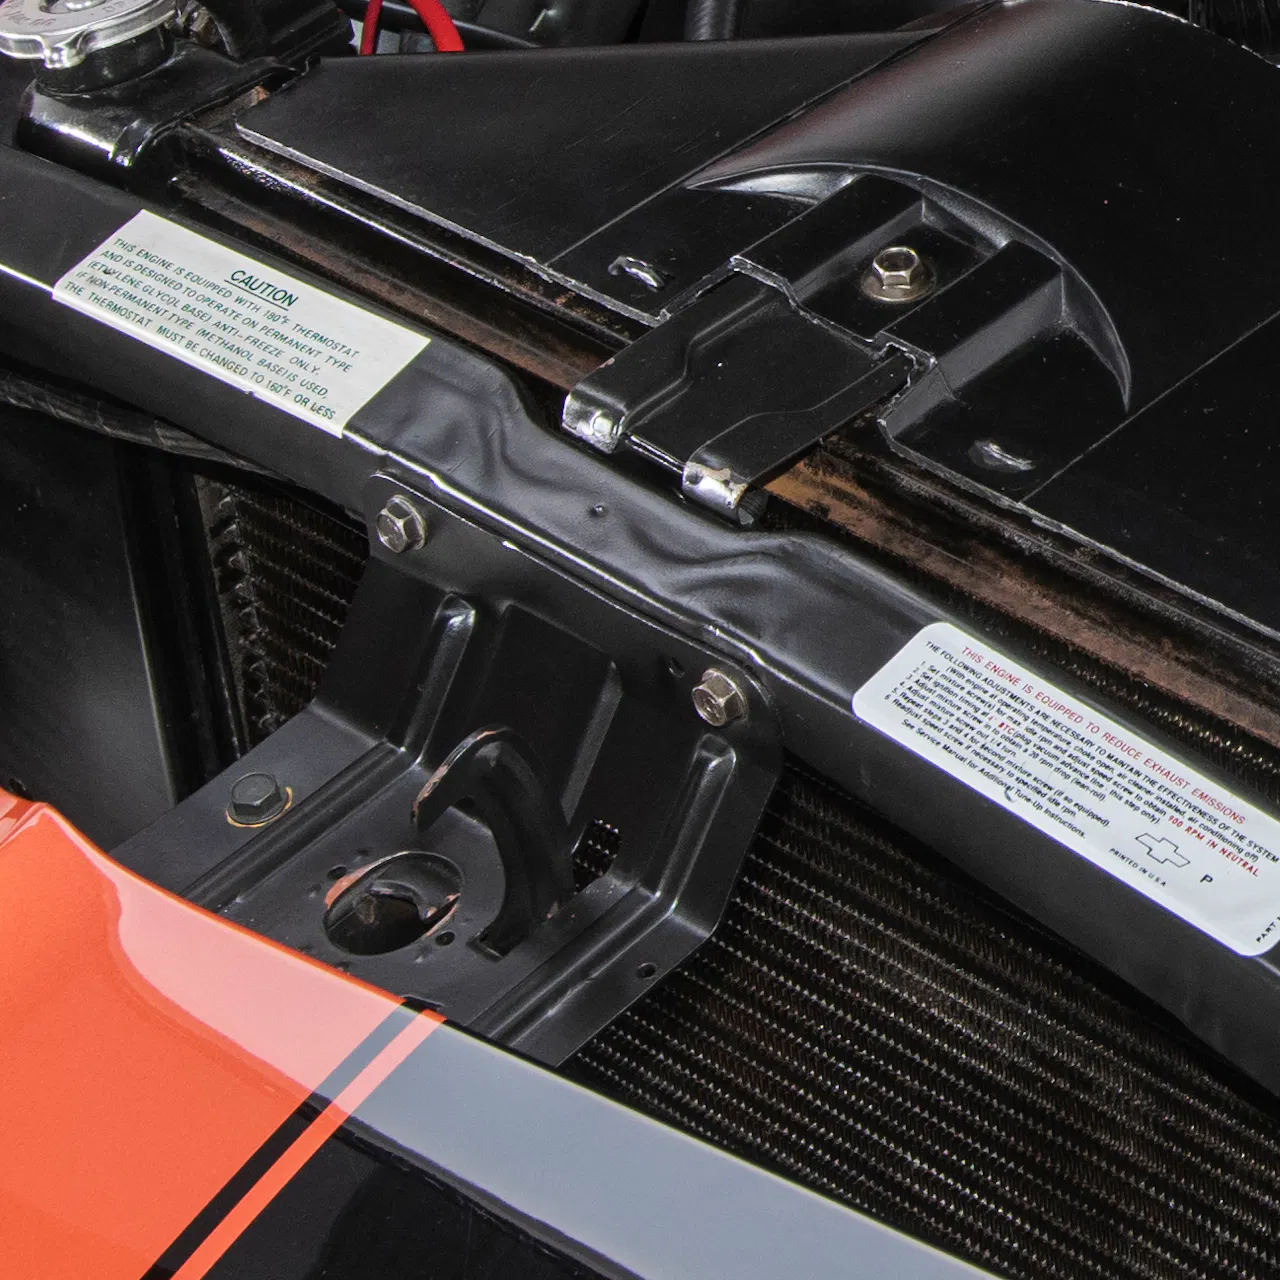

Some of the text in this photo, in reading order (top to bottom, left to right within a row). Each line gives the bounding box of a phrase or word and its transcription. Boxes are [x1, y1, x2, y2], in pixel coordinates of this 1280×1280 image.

[86, 275, 169, 316] NON-PERMANENT
[167, 312, 195, 330] TYPE
[195, 328, 253, 361] (METHANOL
[256, 358, 288, 376] BASE)
[299, 378, 328, 399] USED,
[100, 250, 124, 263] AND
[133, 263, 183, 290] DESIGNED
[182, 286, 197, 298] TO
[195, 294, 242, 320] OPERATE
[241, 317, 259, 329] ON
[258, 325, 322, 357] PERMANENT
[325, 355, 352, 373] TYPE
[113, 238, 137, 252] THIS
[135, 248, 174, 270] ENGINE
[183, 271, 232, 298] EQUIPPED
[233, 295, 261, 313] WITH
[292, 323, 359, 357] THERMOSTAT
[142, 284, 180, 308] GLYCOL
[180, 303, 212, 322] BASE)
[211, 320, 284, 357] ANTI-FREEZE
[289, 356, 320, 375] ONLY.
[230, 270, 298, 306] CAUTION
[64, 281, 85, 295] THE
[88, 292, 152, 327] THERMOSTAT
[156, 325, 186, 344] MUST
[184, 339, 200, 352] BE
[199, 347, 248, 376] CHANGED
[250, 371, 265, 384] TO
[293, 393, 310, 407] OR
[309, 402, 336, 420] LESS
[892, 698, 922, 719] Readjust
[922, 718, 944, 733] speed
[943, 731, 964, 746] screw
[970, 749, 1005, 773] necessary
[1015, 776, 1047, 798] specified
[1047, 796, 1061, 807] idle
[899, 692, 923, 709] Repeat
[923, 707, 942, 721] steps
[979, 743, 1006, 761] second
[1005, 759, 1032, 777] mixture
[1032, 776, 1053, 791] screw
[906, 685, 929, 701] Adjust
[928, 700, 955, 717] mixture
[955, 716, 975, 731] screw
[913, 679, 936, 695] Adjust
[935, 693, 962, 711] mixture
[962, 710, 983, 724] screw
[1000, 734, 1022, 749] obtain
[1038, 757, 1054, 768] rpm
[1053, 766, 1071, 780] drop
[926, 641, 941, 653] THE
[940, 650, 983, 679] FOLLOWING
[981, 677, 1035, 711] ADJUSTMENTS
[1034, 709, 1051, 721] ARE
[1050, 719, 1095, 747] NECESSARY
[1106, 752, 1142, 777] MAINTAIN
[1142, 774, 1158, 787] THE
[1157, 784, 1218, 825] EFFECTIVENESS
[1231, 829, 1247, 843] THE
[1248, 840, 1279, 863] SYSTEM
[932, 680, 958, 698] ignition
[958, 695, 981, 712] timing
[1012, 731, 1032, 745] (plug
[1032, 743, 1060, 761] vacuum
[1059, 760, 1090, 780] advance
[1089, 777, 1104, 788] line
[1109, 789, 1123, 801] this
[1124, 799, 1140, 811] step
[945, 666, 965, 680] (With
[965, 678, 989, 694] engine
[997, 698, 1030, 721] operating
[1073, 745, 1096, 760] choke
[1127, 779, 1154, 796] cleaner
[1198, 823, 1244, 854] conditioning
[961, 646, 1245, 824] THIS ENGINE IS EQUIPPED TO REDUCE EXHAUST EMISSIONS
[901, 718, 915, 729] See
[916, 727, 941, 746] Service
[941, 743, 968, 762] Manual
[978, 767, 1014, 791] Additional
[1014, 789, 1043, 810] Tune-Up
[1043, 807, 1085, 838] Instructions.
[939, 673, 965, 691] mixture
[966, 690, 995, 710] screw(s)
[1037, 734, 1053, 746] rpm
[1067, 753, 1090, 768] adjust
[1090, 767, 1113, 782] speed
[1112, 780, 1133, 795] screw
[1143, 800, 1166, 816] obtain
[1168, 815, 1183, 827] 900
[1184, 825, 1205, 840] RPM
[1219, 847, 1258, 877] NEUTRAL
[1109, 848, 1138, 868] PRINTED
[1256, 922, 1276, 942] PART
